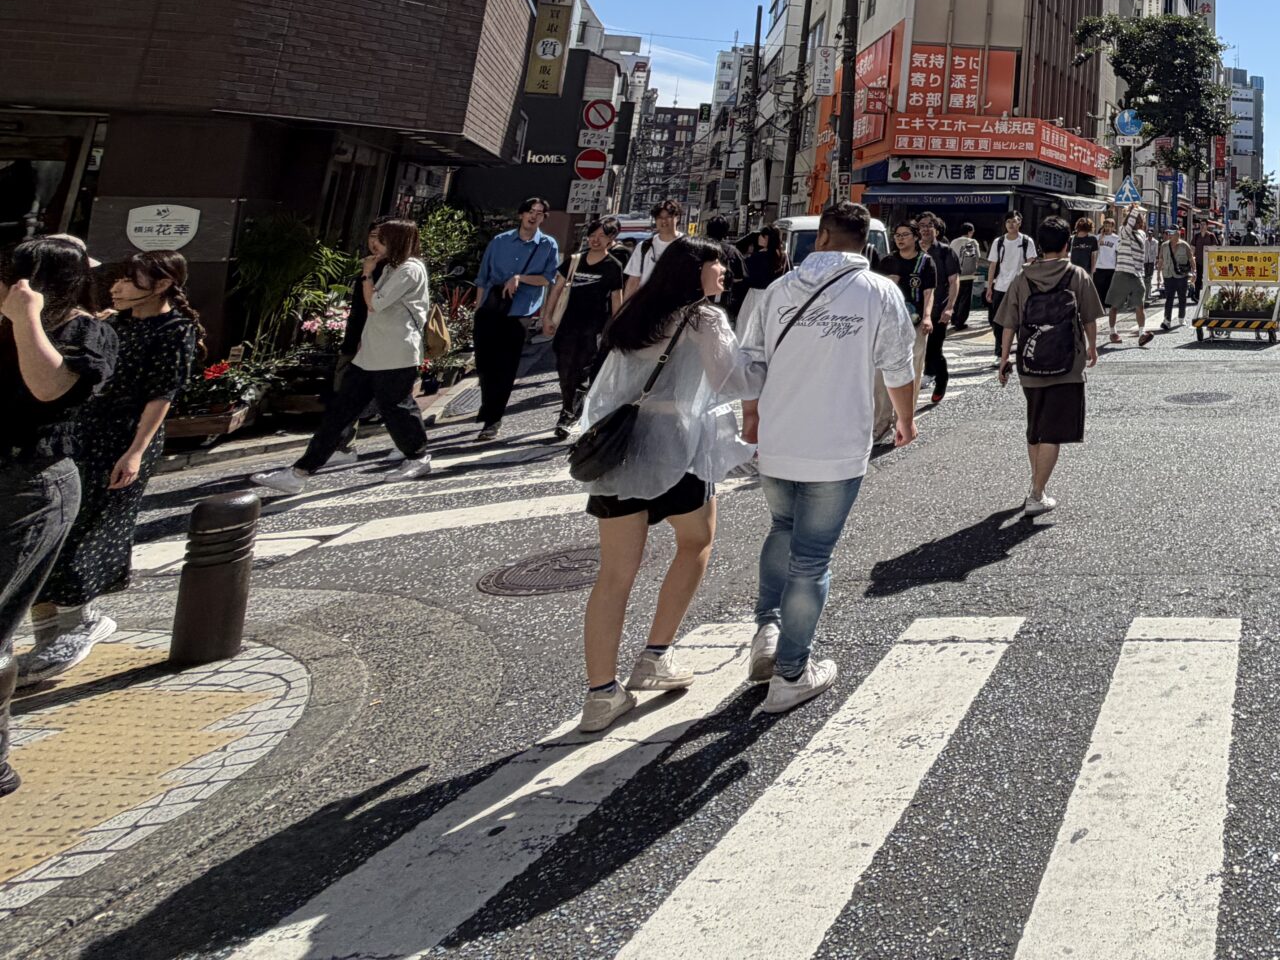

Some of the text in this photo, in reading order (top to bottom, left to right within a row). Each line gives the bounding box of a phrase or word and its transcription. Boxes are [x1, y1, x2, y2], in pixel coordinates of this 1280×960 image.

[540, 40, 557, 58] 質
[912, 53, 981, 70] 気持ちに
[911, 72, 980, 89] 寄り添う
[896, 117, 1036, 136] エキマエホーム横浜店
[897, 137, 925, 148] 賃貸
[930, 138, 957, 150] 管理
[993, 141, 1034, 151] 当ビル2階
[936, 164, 976, 180] 八百徳
[982, 165, 1021, 181] 西口店
[1218, 265, 1269, 278] 進入禁止
